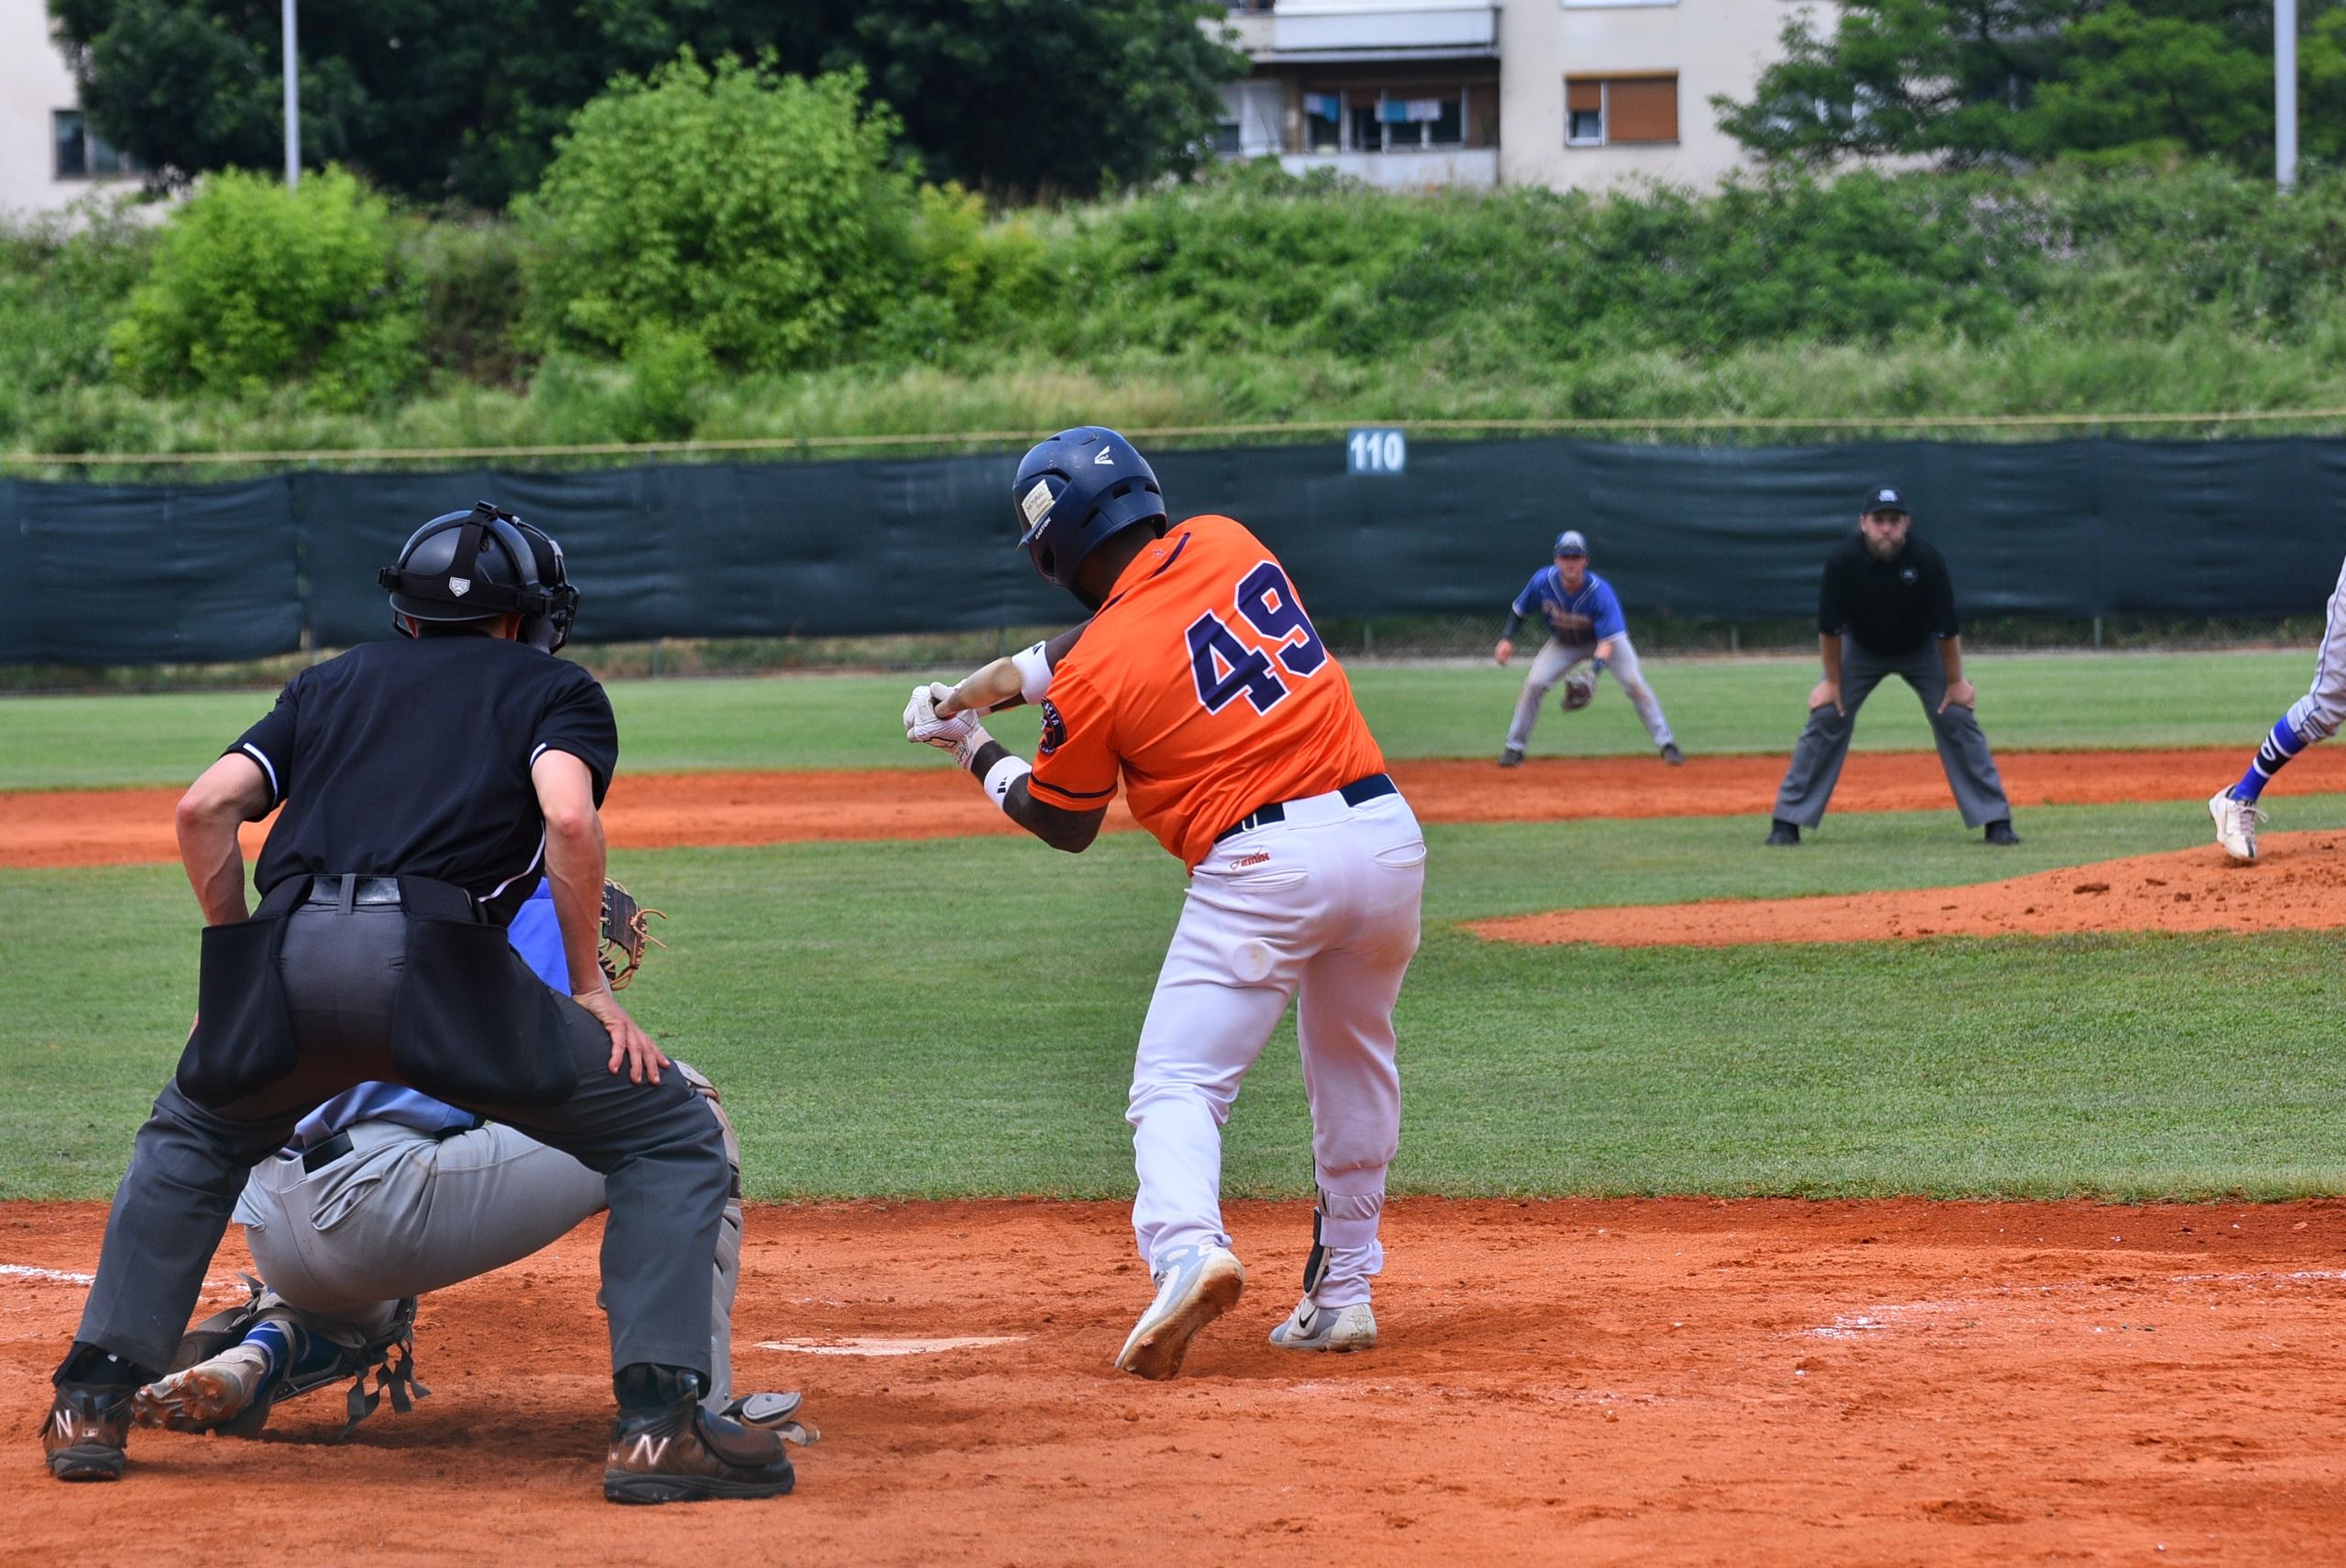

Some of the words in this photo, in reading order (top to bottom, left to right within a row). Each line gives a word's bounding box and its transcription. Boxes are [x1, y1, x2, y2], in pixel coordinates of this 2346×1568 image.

[1350, 432, 1406, 471] 110
[1035, 517, 1051, 540] EASTON
[1185, 560, 1328, 717] 49
[56, 1409, 73, 1439] N
[628, 1433, 671, 1465] N
